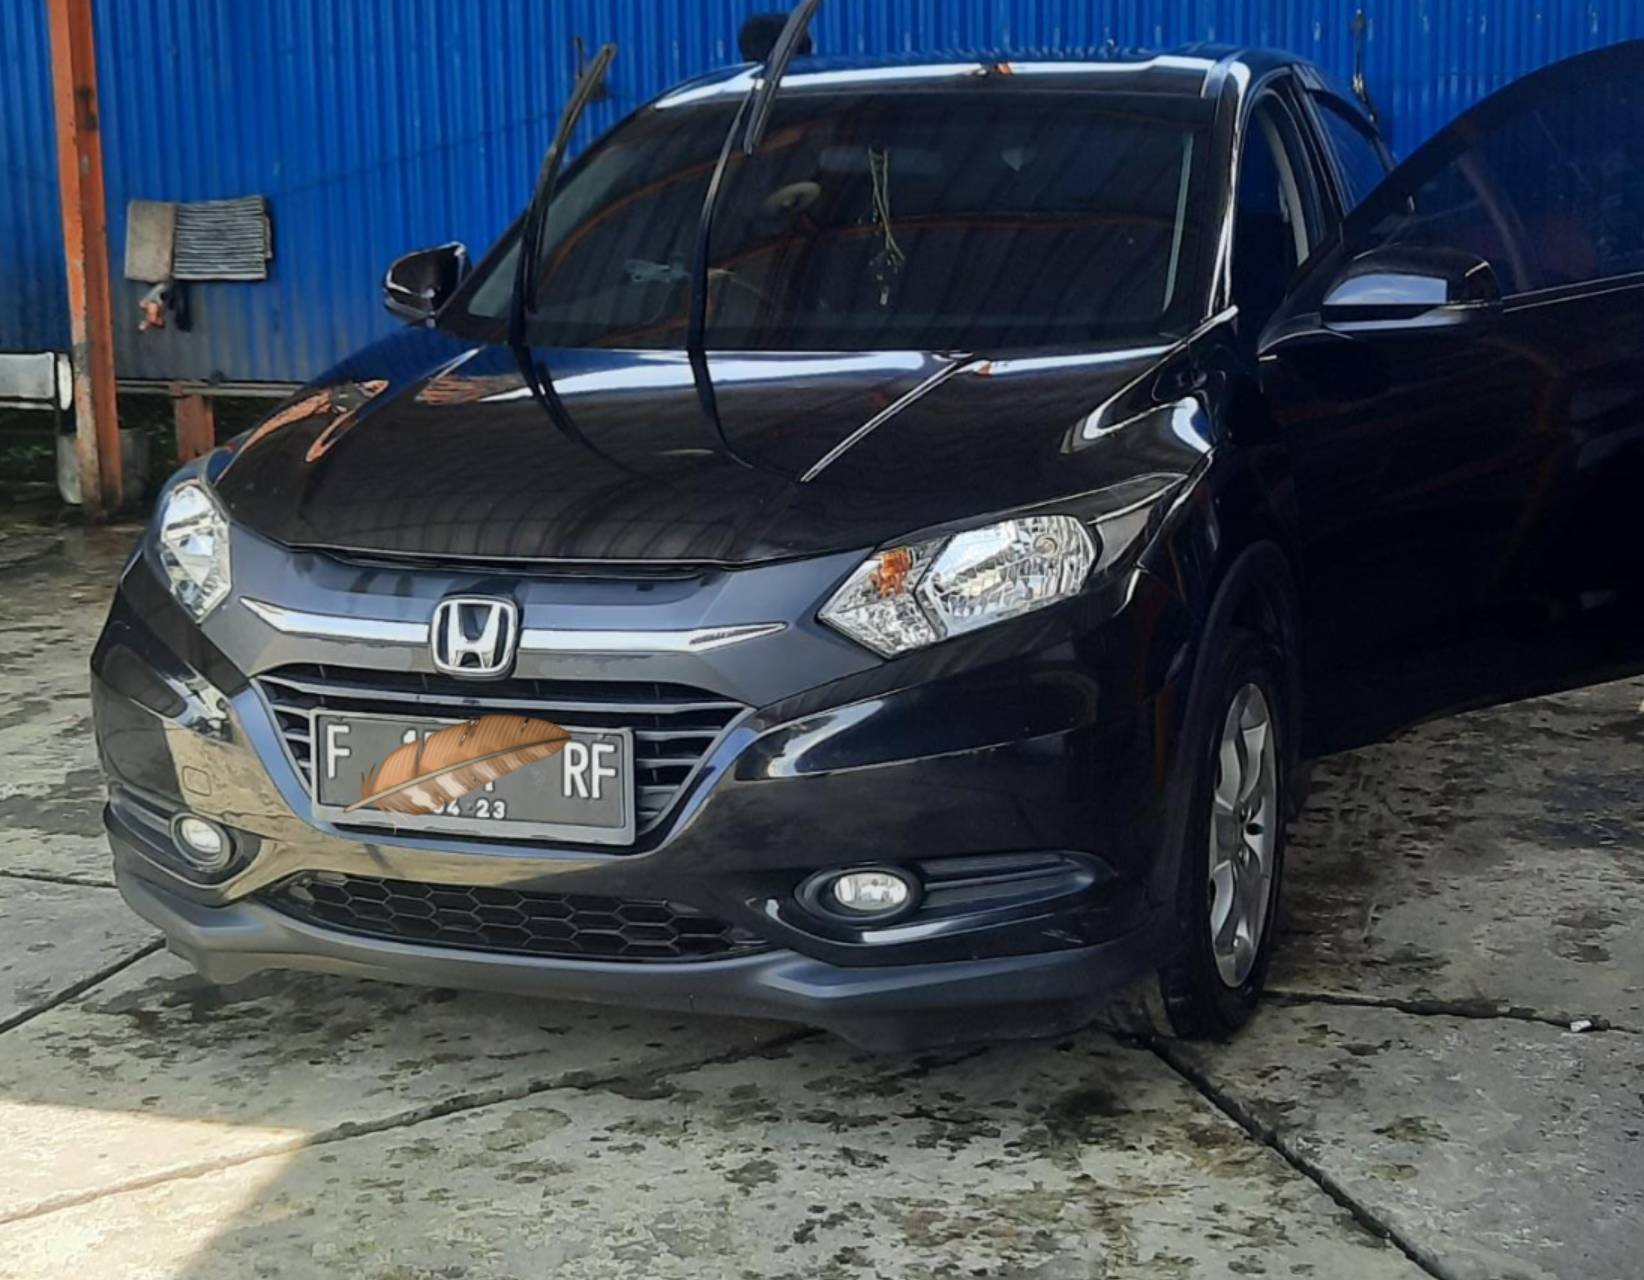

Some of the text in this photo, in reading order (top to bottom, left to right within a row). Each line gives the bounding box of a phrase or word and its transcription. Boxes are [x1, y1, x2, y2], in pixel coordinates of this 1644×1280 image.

[326, 724, 350, 778] F
[563, 741, 617, 800] RF
[475, 798, 506, 820] 23
